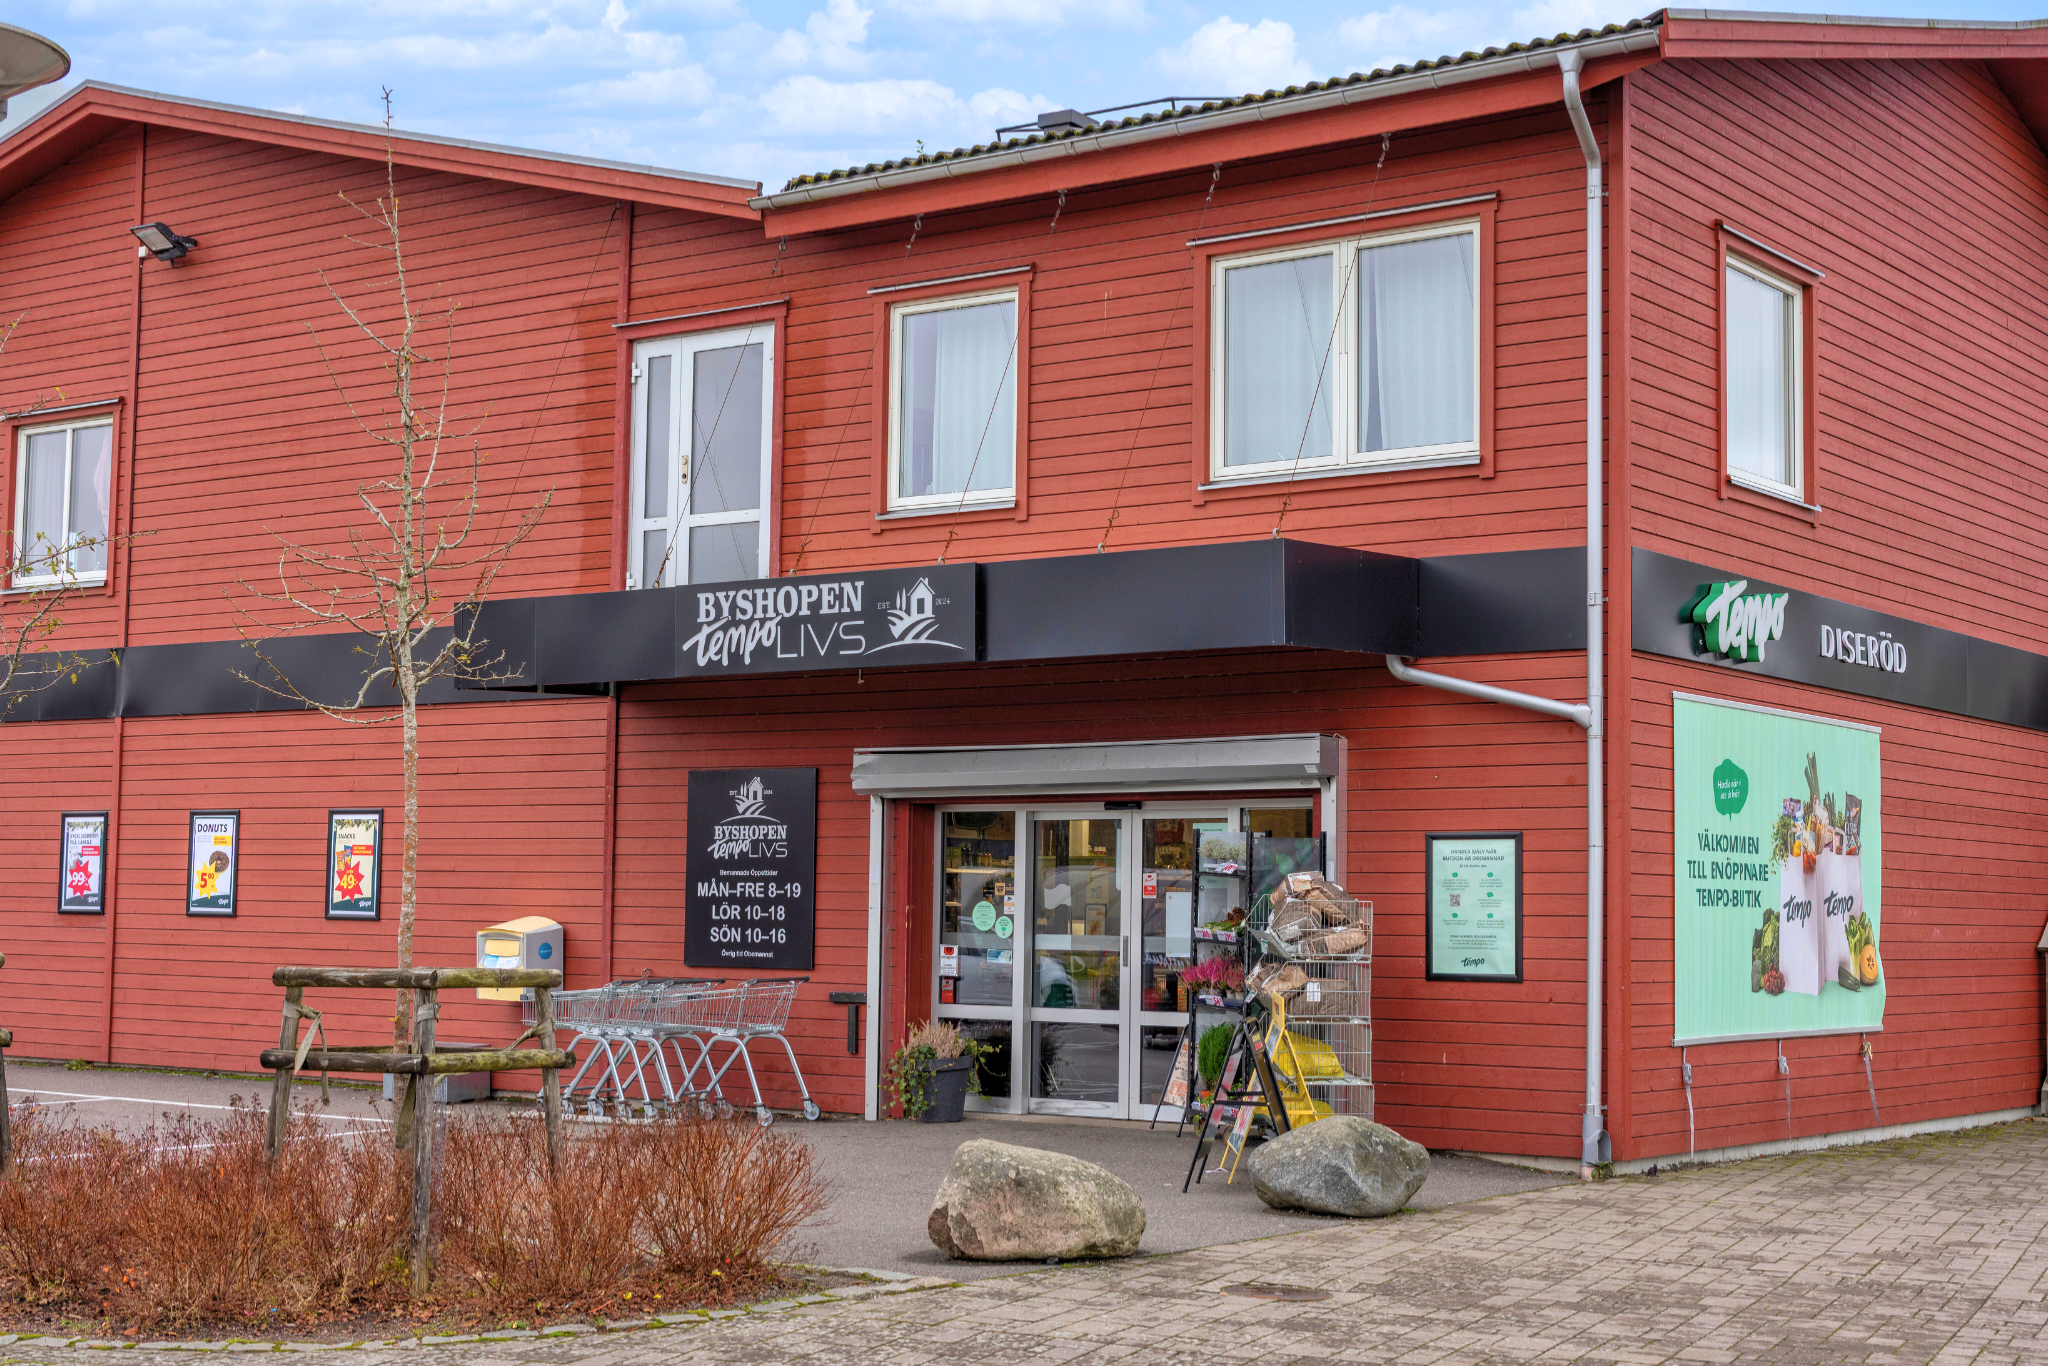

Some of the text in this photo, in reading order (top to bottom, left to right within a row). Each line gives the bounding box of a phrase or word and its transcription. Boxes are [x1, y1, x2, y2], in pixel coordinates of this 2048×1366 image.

[697, 580, 865, 622] BYSHOPEN
[777, 620, 866, 659] LIVS
[1820, 624, 1907, 673] DISERÖD
[197, 823, 228, 833] DONUTS
[713, 825, 788, 840] BYSHOPEN
[748, 842, 788, 858] LIVS
[1697, 828, 1759, 855] VÄLKOMMEN
[1686, 856, 1769, 882] TILL EN ÖPPNARE
[711, 901, 741, 920] LÖR
[710, 924, 741, 943] SÖN
[721, 949, 736, 958] Övrig
